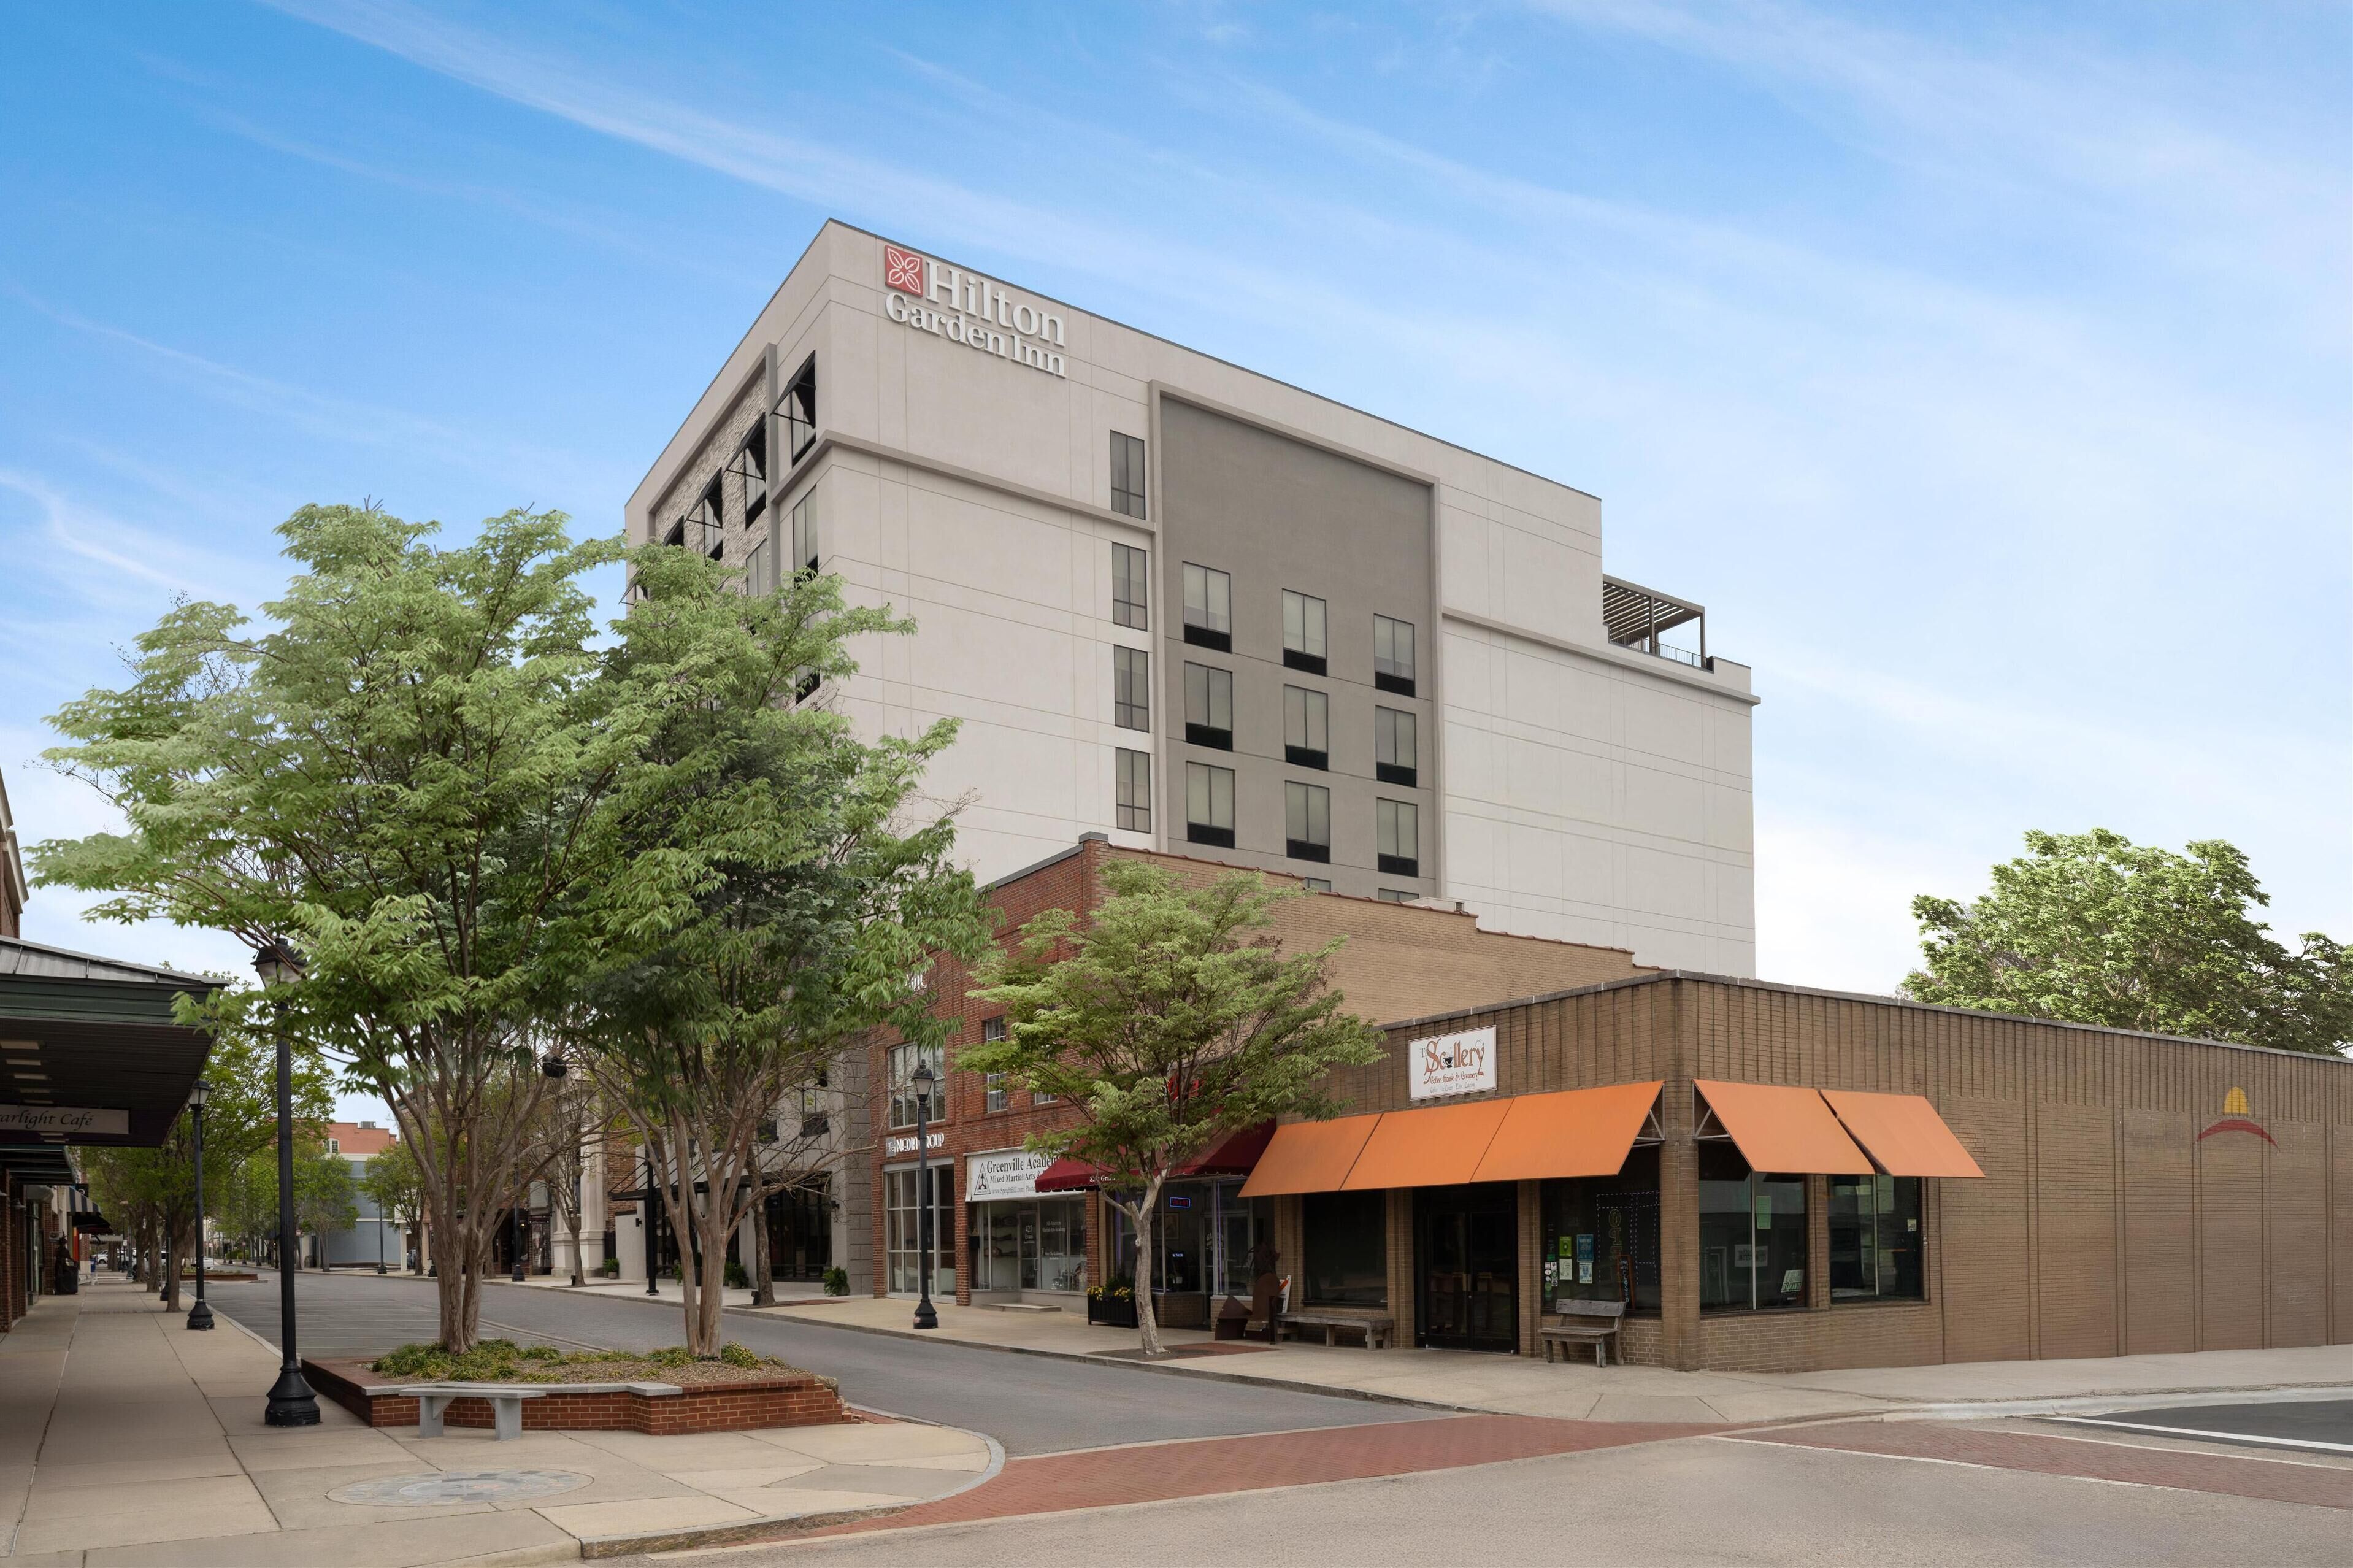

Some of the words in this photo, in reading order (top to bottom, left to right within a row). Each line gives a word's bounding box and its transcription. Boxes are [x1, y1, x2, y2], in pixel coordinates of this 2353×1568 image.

[926, 259, 1065, 348] Hilton
[885, 291, 1007, 358] Garden
[1011, 333, 1067, 379] Inn
[0, 1109, 56, 1129] arlight
[61, 1112, 94, 1131] Café
[896, 1136, 918, 1153] MEDIA
[918, 1132, 945, 1149] ROUP
[986, 1158, 1024, 1174] Greenville
[1026, 1154, 1059, 1170] Academ
[989, 1174, 1005, 1183] Mixed
[1006, 1172, 1024, 1182] Martial
[1026, 1172, 1035, 1181] Arts
